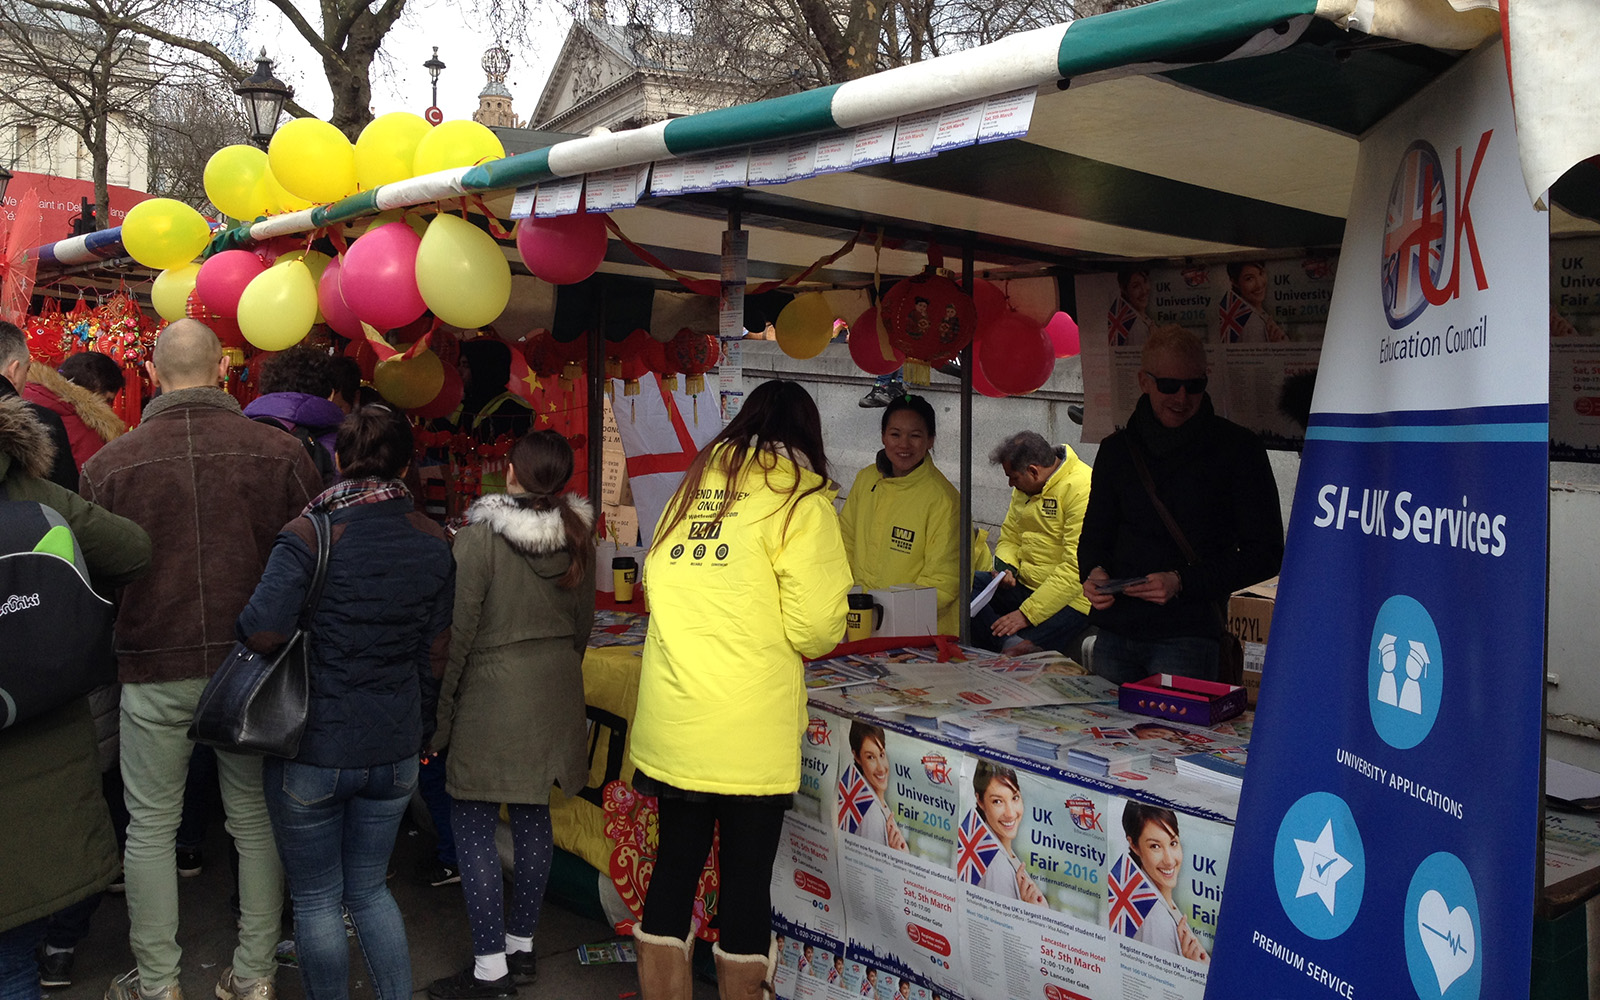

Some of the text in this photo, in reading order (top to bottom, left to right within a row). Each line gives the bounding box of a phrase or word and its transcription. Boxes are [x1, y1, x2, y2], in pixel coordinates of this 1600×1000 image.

[1561, 257, 1584, 271] UK
[1156, 282, 1171, 292] UK
[1274, 274, 1290, 286] UK
[1156, 296, 1212, 308] University
[1274, 289, 1332, 300] University
[1560, 294, 1589, 307] Fair
[1157, 310, 1177, 322] Fair
[1276, 304, 1328, 316] Fair 2016
[1379, 315, 1488, 364] Education Council
[690, 522, 720, 538] 24/7
[1313, 484, 1507, 557] SI-UK Services
[894, 763, 912, 780] UK
[1336, 748, 1463, 820] UNIVERSITY APPLICATIONS
[897, 782, 956, 816] University
[898, 802, 951, 831] Fair 2016
[1032, 806, 1054, 826] UK
[904, 823, 934, 838] international
[934, 833, 954, 846] students
[1031, 829, 1106, 867] University
[1030, 851, 1098, 884] Fair 2016
[1192, 854, 1217, 876] UK
[904, 878, 924, 891] Lancaster
[925, 886, 942, 898] London
[1040, 875, 1077, 891] international
[1077, 887, 1102, 899] students
[904, 886, 952, 913] Sat, 5th March
[911, 910, 932, 924] Lancaster
[966, 890, 984, 900] Register
[1023, 910, 1042, 919] largest
[1042, 915, 1074, 931] international
[1074, 926, 1094, 938] student
[1040, 934, 1106, 963] Lancaster London Hotel
[1040, 944, 1102, 974] Sat, 5th March
[1120, 942, 1141, 955] Register
[1141, 952, 1153, 960] now
[1162, 959, 1172, 967] the
[1185, 966, 1206, 979] largest
[1252, 930, 1355, 1000] PREMIUM SERVICE
[1050, 970, 1076, 985] Lancaster
